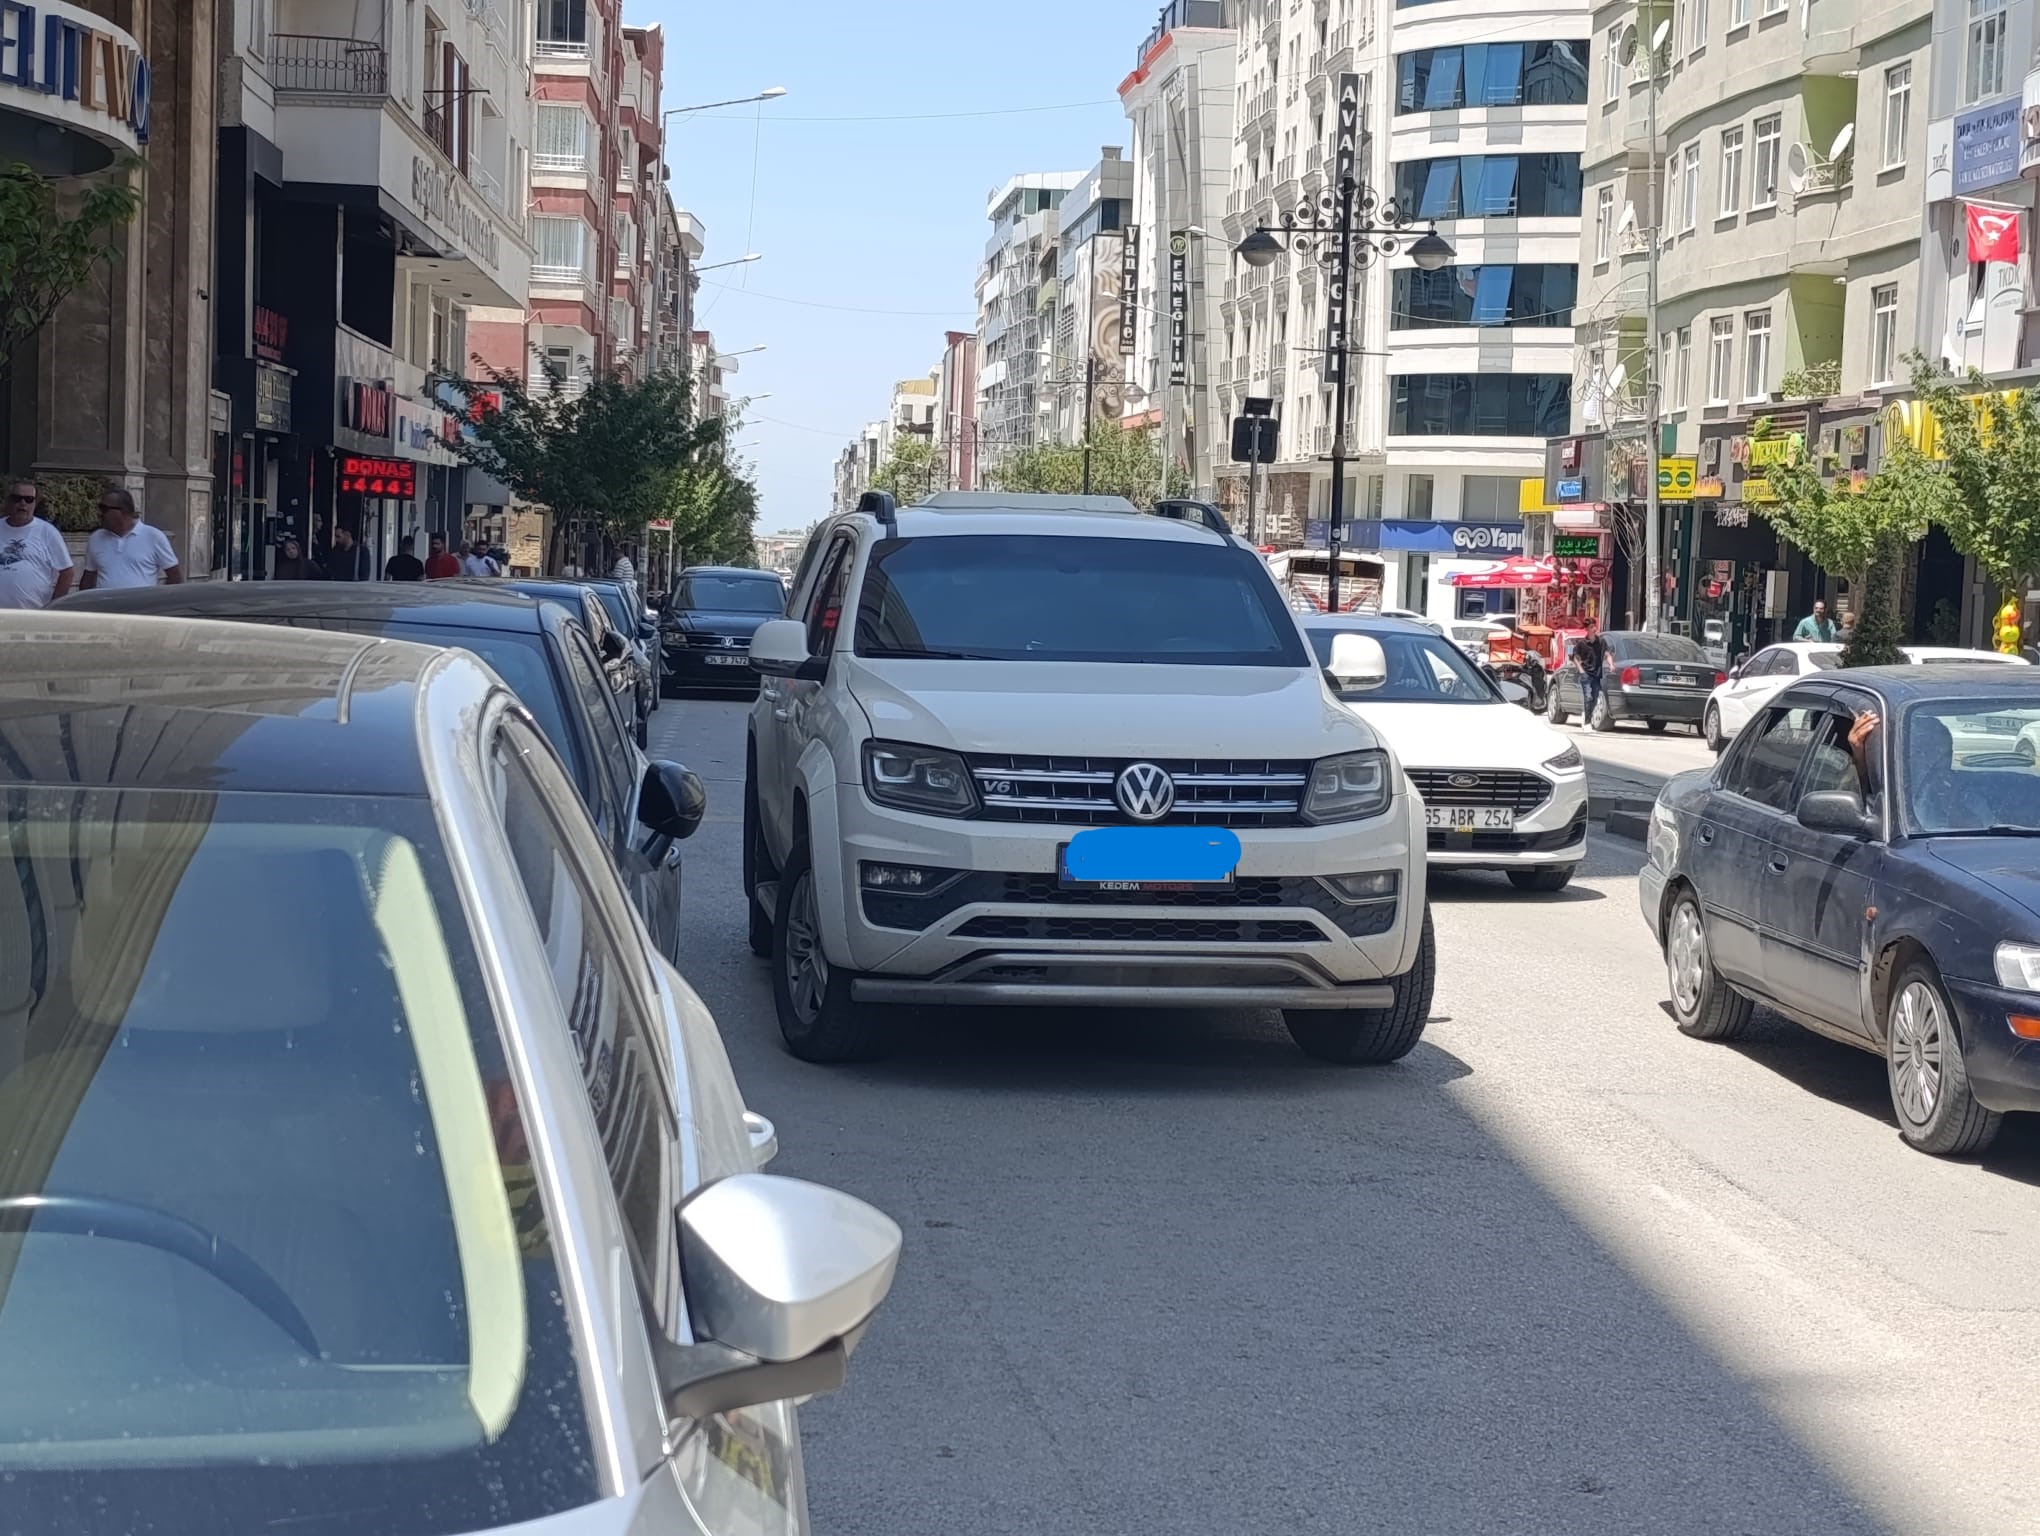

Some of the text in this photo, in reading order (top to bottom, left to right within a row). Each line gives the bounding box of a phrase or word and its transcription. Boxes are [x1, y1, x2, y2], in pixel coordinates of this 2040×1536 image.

[1124, 226, 1138, 270] Van
[1172, 259, 1183, 292] FEN
[1123, 274, 1136, 339] Life
[983, 780, 1011, 793] V6
[1450, 808, 1475, 826] ABR
[1484, 809, 1510, 826] 254
[1100, 882, 1140, 891] KEDEM
